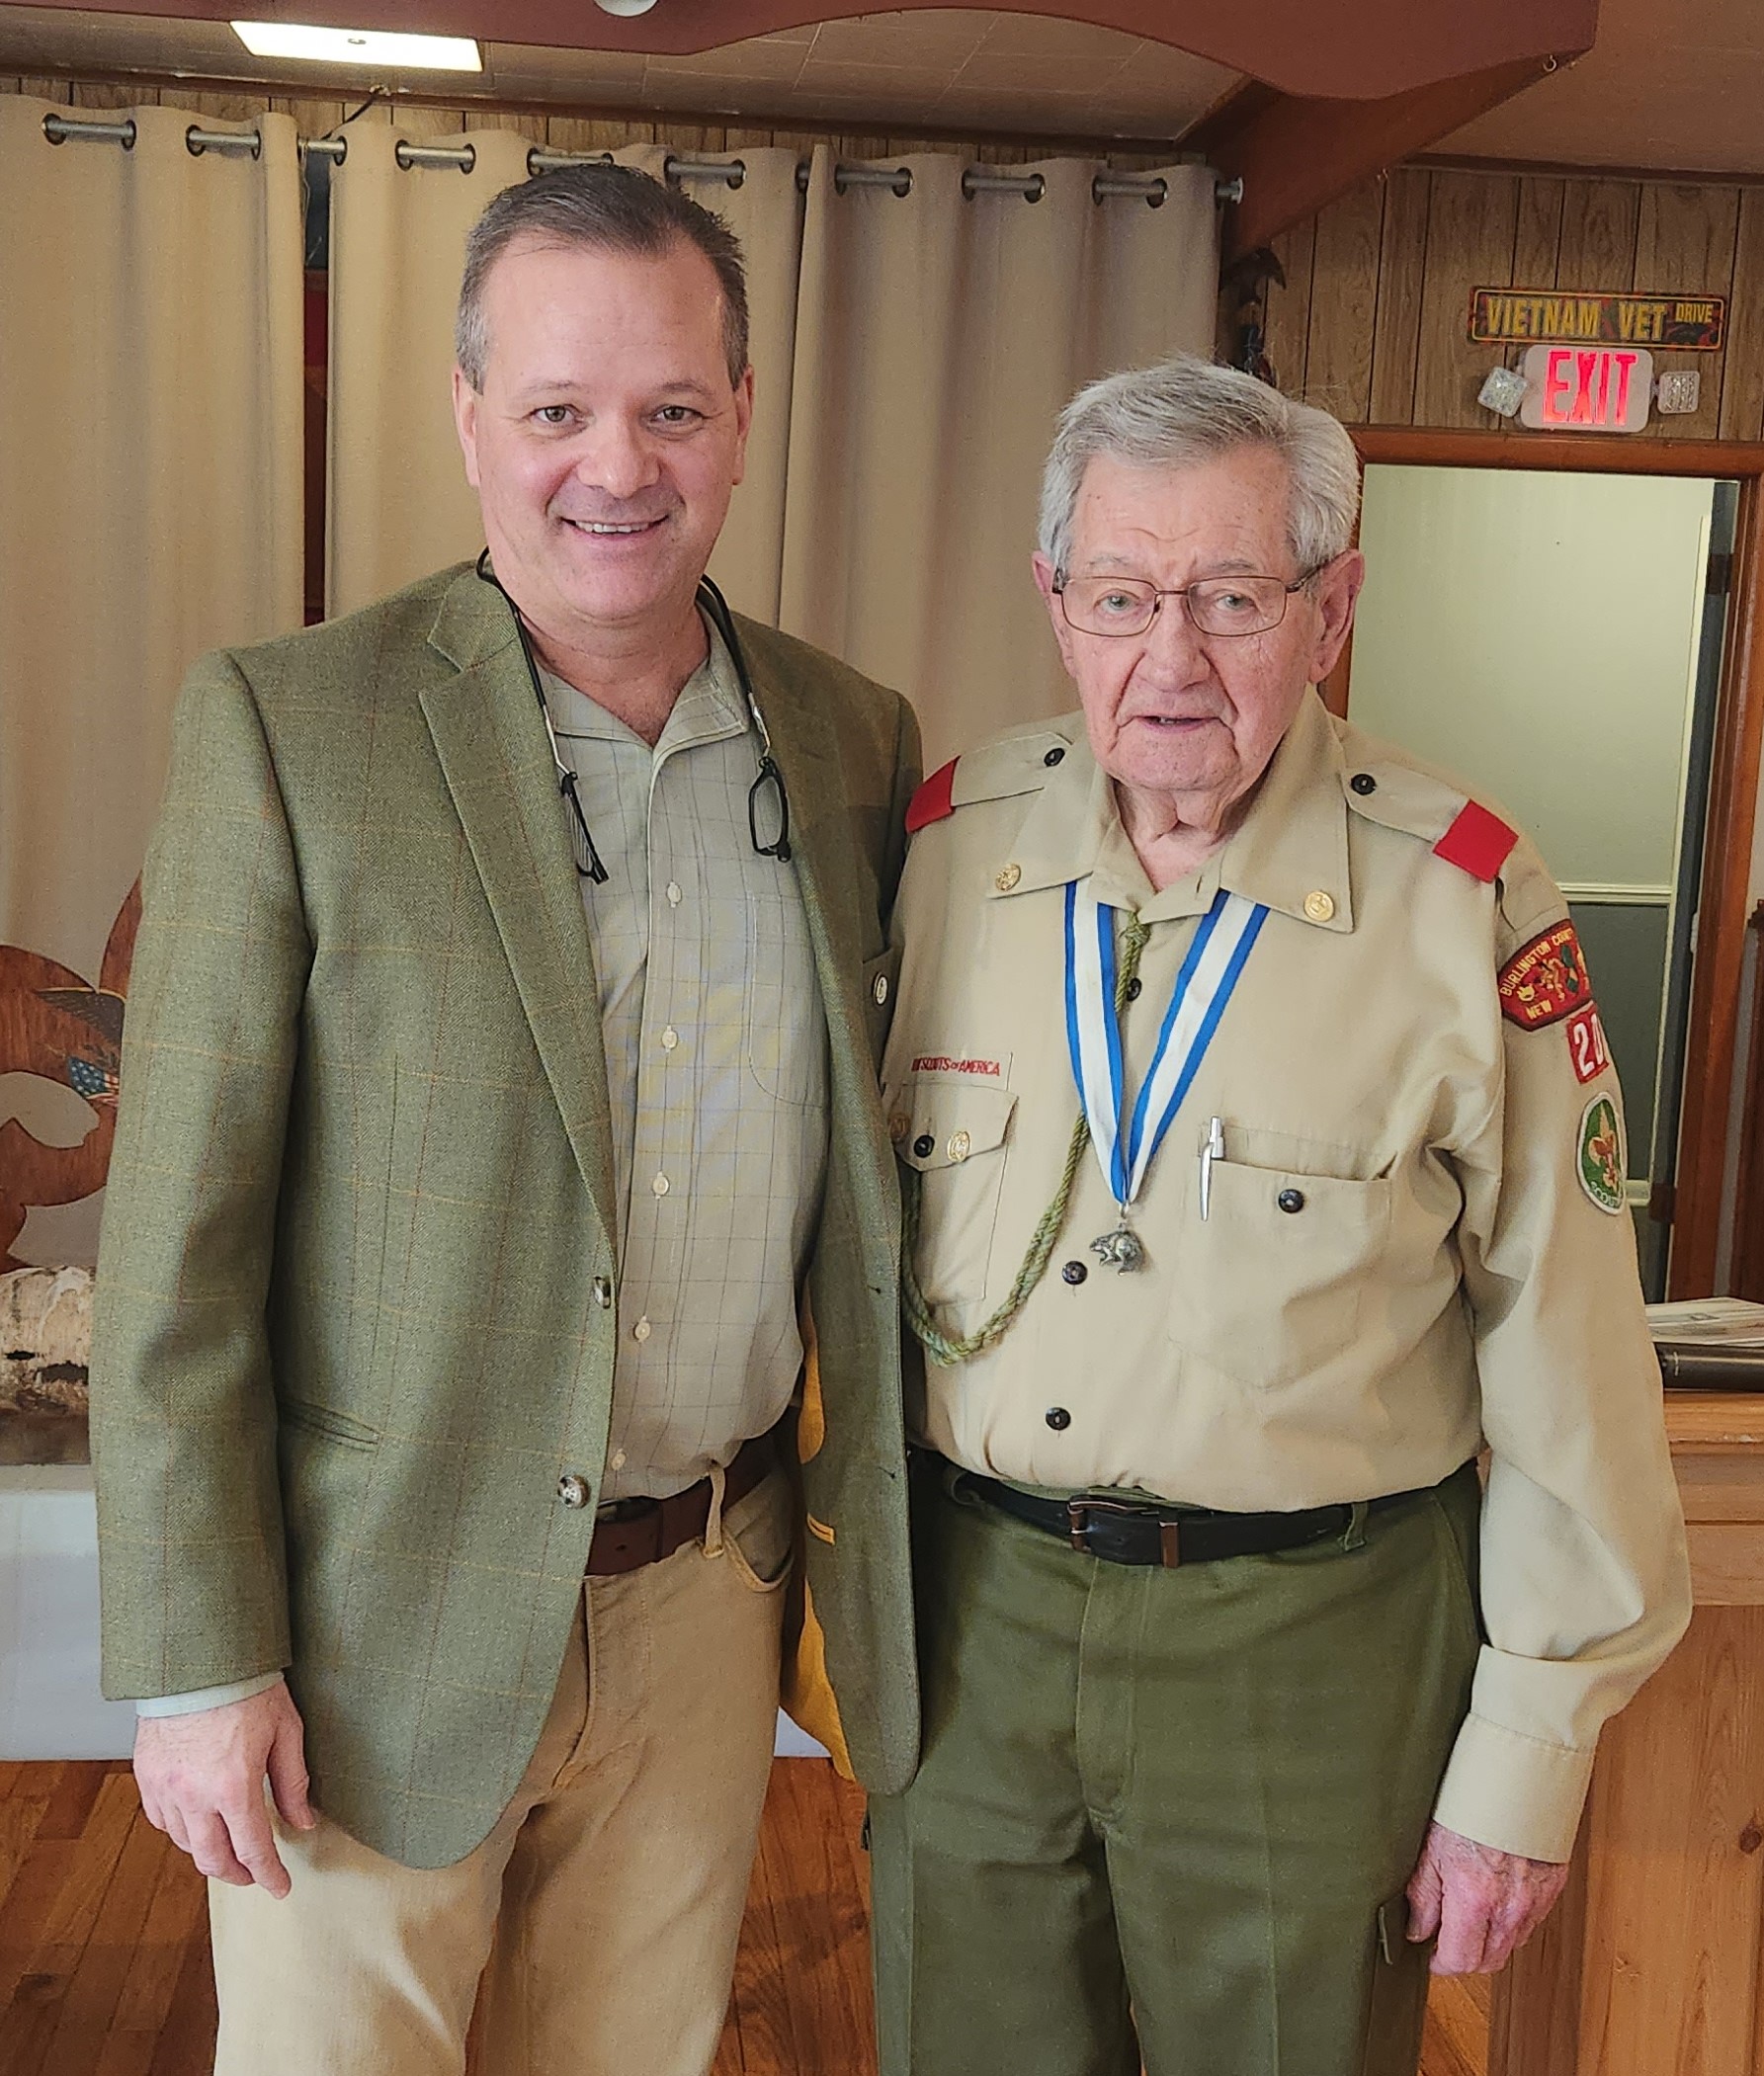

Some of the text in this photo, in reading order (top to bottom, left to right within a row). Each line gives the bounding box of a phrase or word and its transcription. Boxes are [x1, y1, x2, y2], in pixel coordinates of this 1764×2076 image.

[1487, 297, 1714, 341] VIETNAM VET DRIVE
[1543, 349, 1638, 426] EXIT
[1499, 941, 1552, 997] BURLINGTON
[1525, 999, 1553, 1021] NEW
[958, 1059, 1000, 1076] AMERICA
